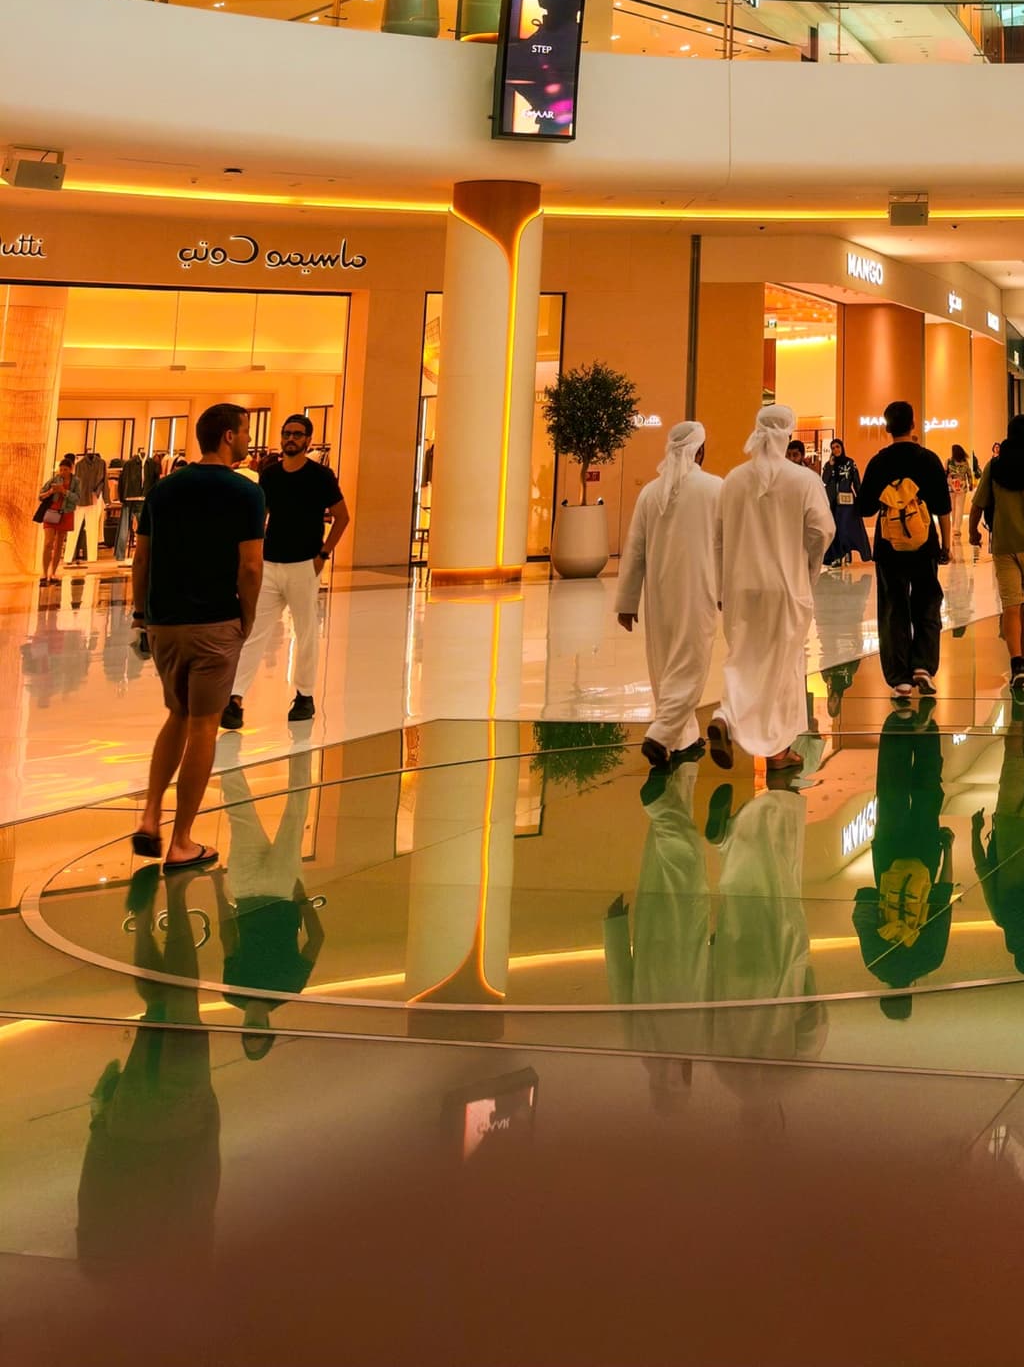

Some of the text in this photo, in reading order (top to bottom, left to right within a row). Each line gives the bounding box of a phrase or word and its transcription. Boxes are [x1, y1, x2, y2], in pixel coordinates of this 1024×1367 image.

[531, 44, 552, 54] STEP
[0, 233, 47, 259] utti
[265, 237, 368, 274] ماسيمو
[847, 252, 884, 285] MANGO
[859, 416, 888, 427] MAN
